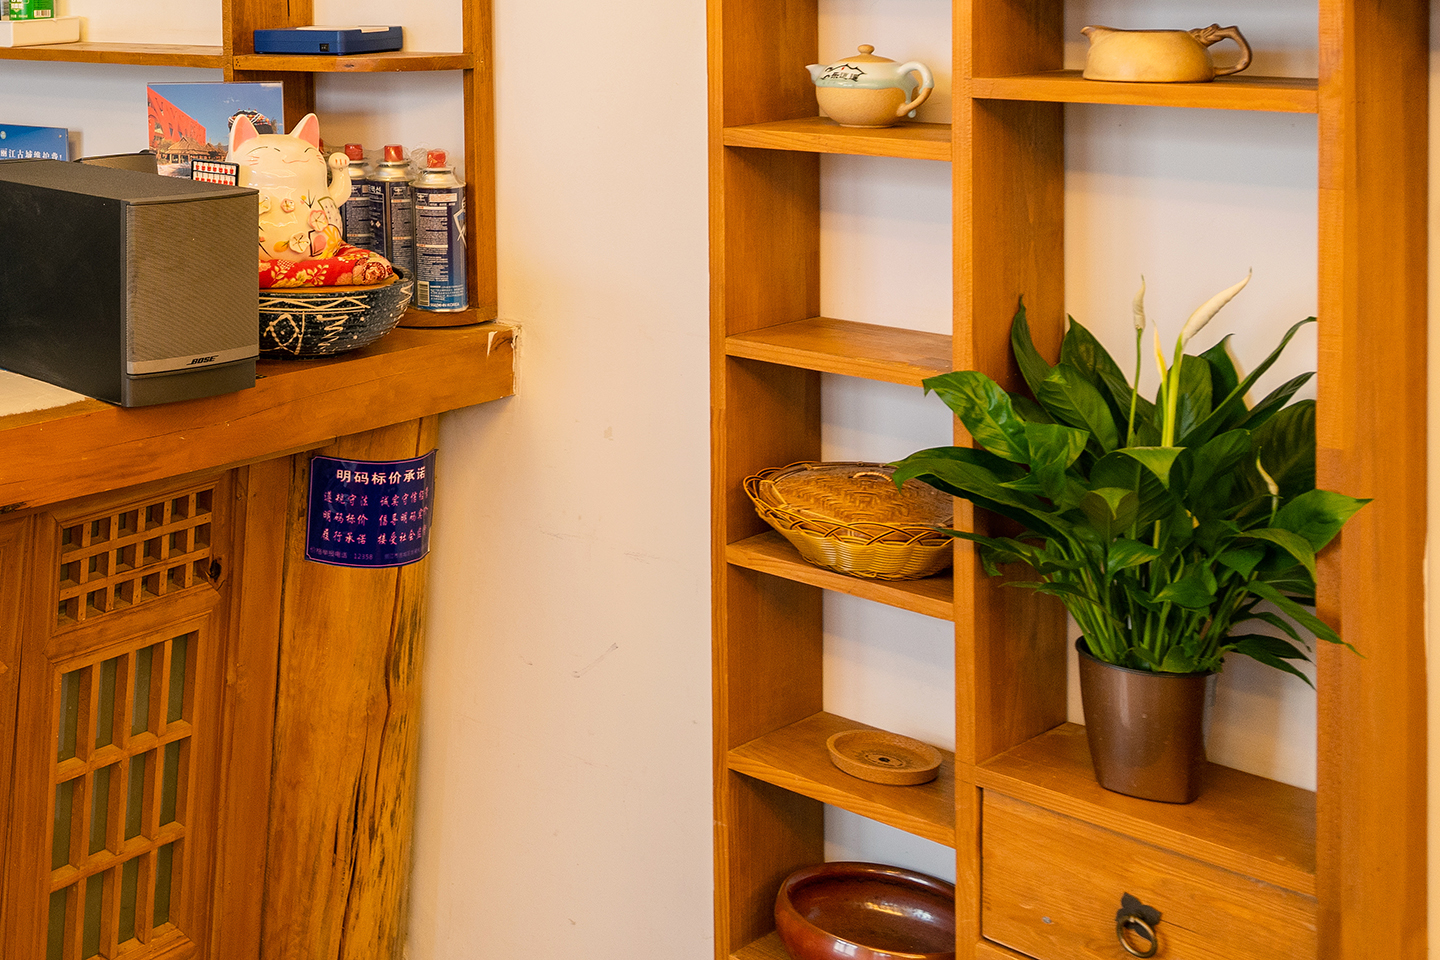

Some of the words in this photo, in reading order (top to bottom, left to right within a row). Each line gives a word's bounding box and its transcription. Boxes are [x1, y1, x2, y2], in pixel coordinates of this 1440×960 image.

[186, 355, 219, 365] BOSE
[336, 465, 426, 486] 明码标价承诺
[322, 510, 369, 527] 明码标价
[320, 528, 367, 545] 履行承诺
